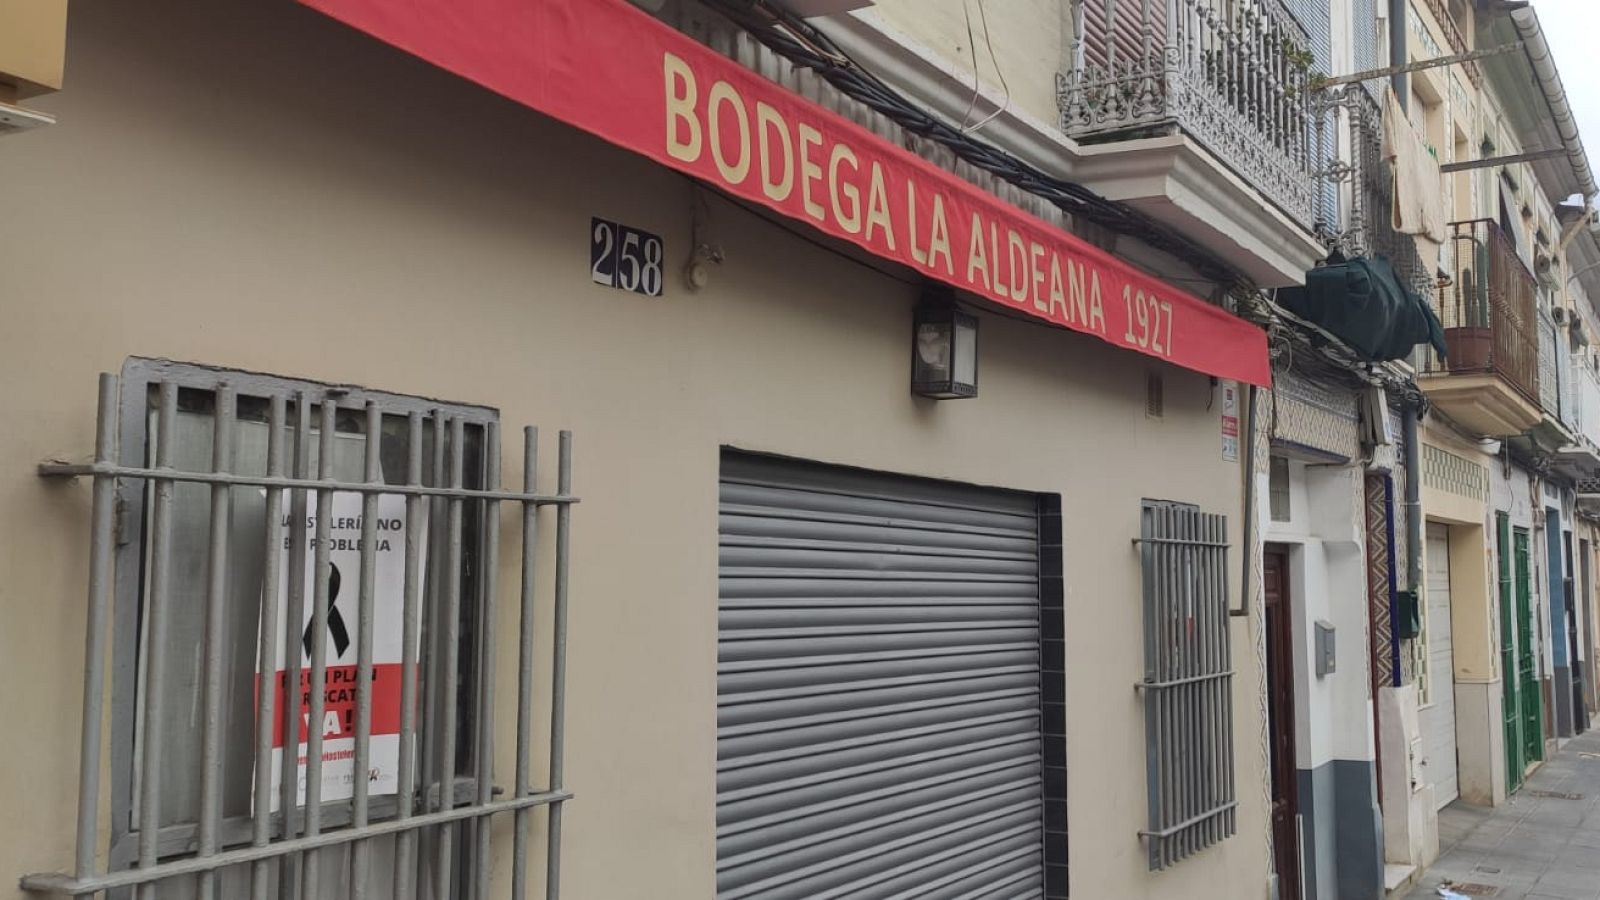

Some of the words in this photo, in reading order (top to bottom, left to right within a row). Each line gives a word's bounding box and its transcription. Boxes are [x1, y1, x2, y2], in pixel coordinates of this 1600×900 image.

[664, 51, 896, 251] BODEGA
[907, 179, 954, 275] LA
[967, 212, 1106, 334] ALDEANA
[1123, 284, 1173, 357] 1927
[592, 223, 662, 296] 258
[377, 518, 402, 531] NO
[310, 538, 391, 552] POBLEA
[303, 688, 361, 706] RCAT
